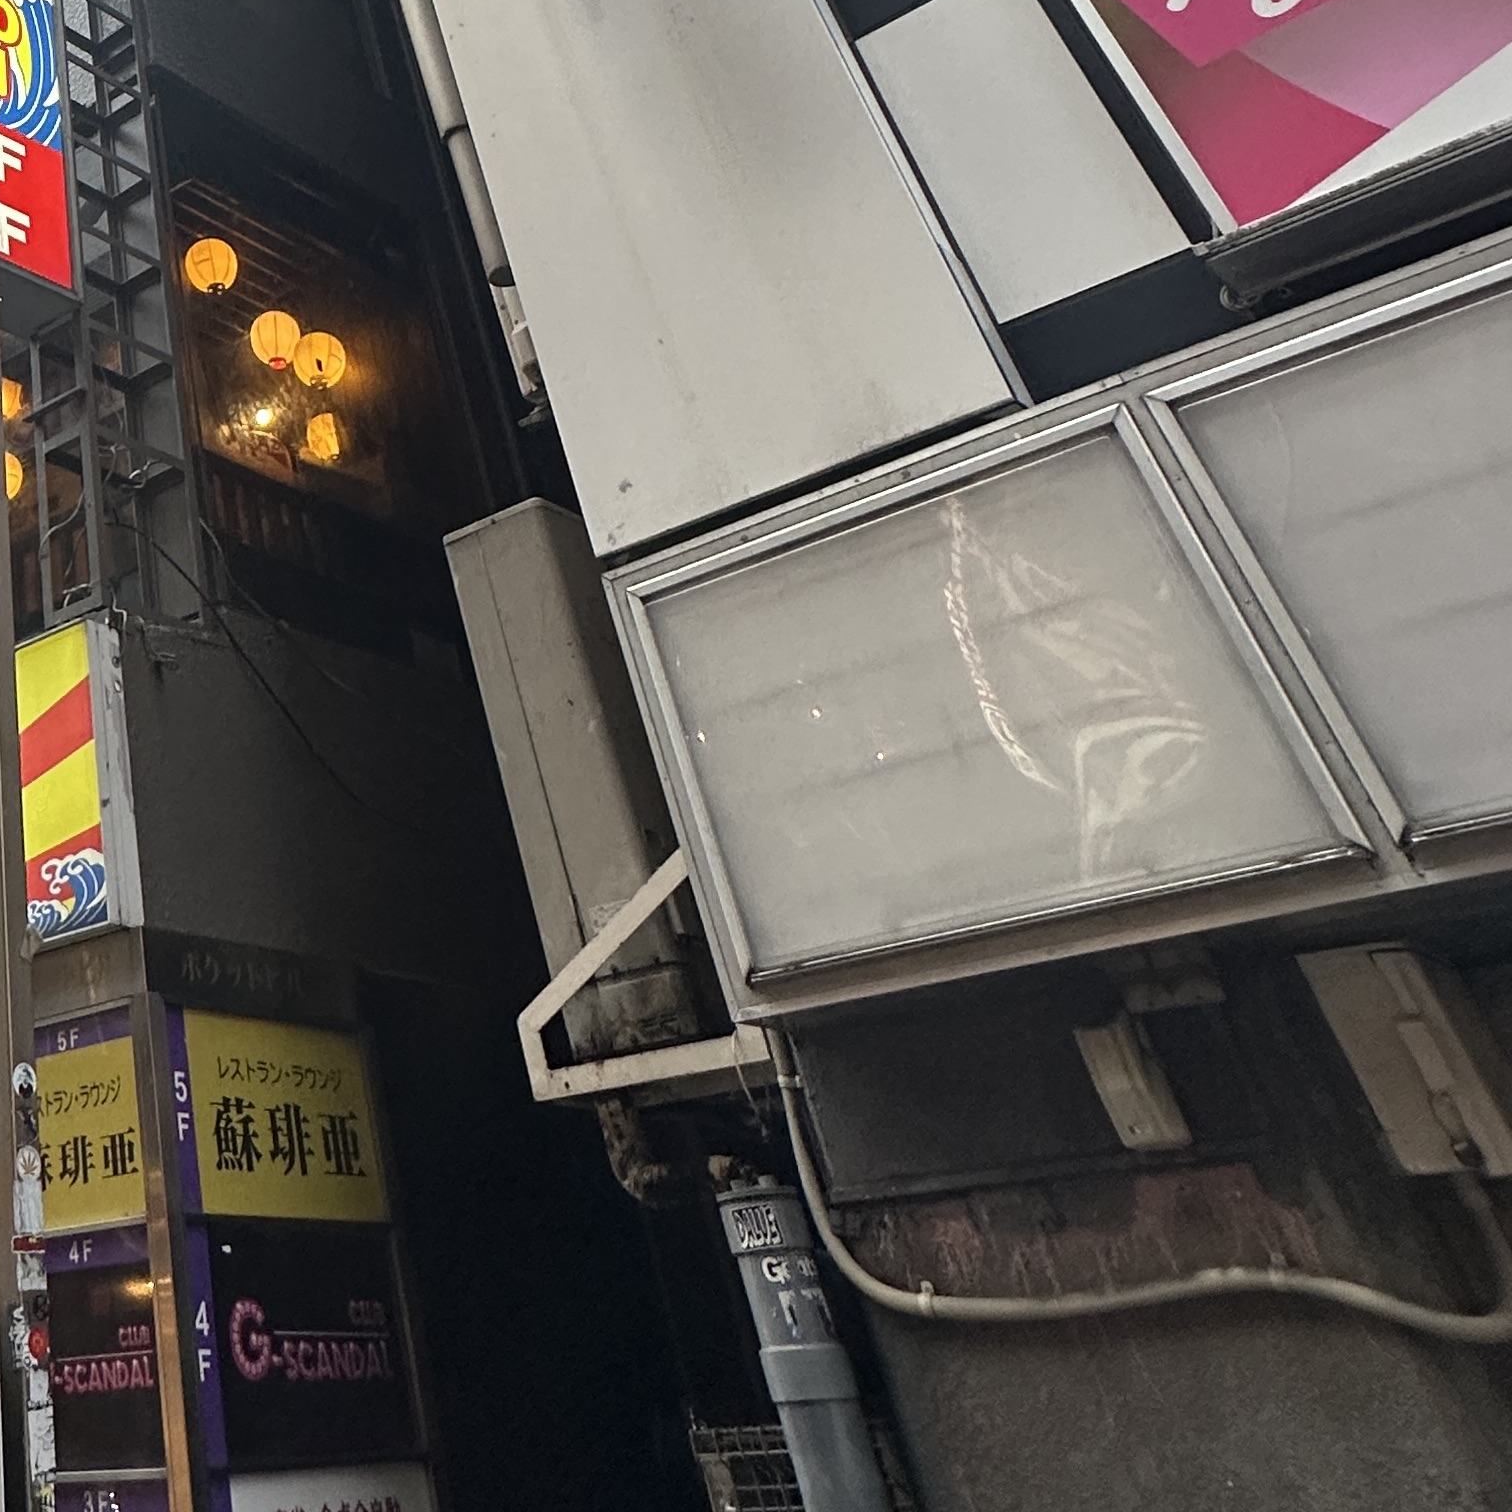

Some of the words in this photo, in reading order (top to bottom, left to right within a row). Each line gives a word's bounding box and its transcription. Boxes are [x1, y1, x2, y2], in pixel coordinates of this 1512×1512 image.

[56, 1027, 80, 1052] 5F
[215, 1055, 344, 1092] レストラン・ラウンジ
[36, 1075, 122, 1119] ストラン・ラウンジ
[173, 1070, 190, 1142] 5F
[209, 1095, 368, 1178] 蘇琲亜
[68, 1236, 93, 1264] 4F
[195, 1298, 212, 1383] 4F
[229, 1296, 391, 1381] G-SCANDAL
[51, 1356, 155, 1396] -SCANDAL
